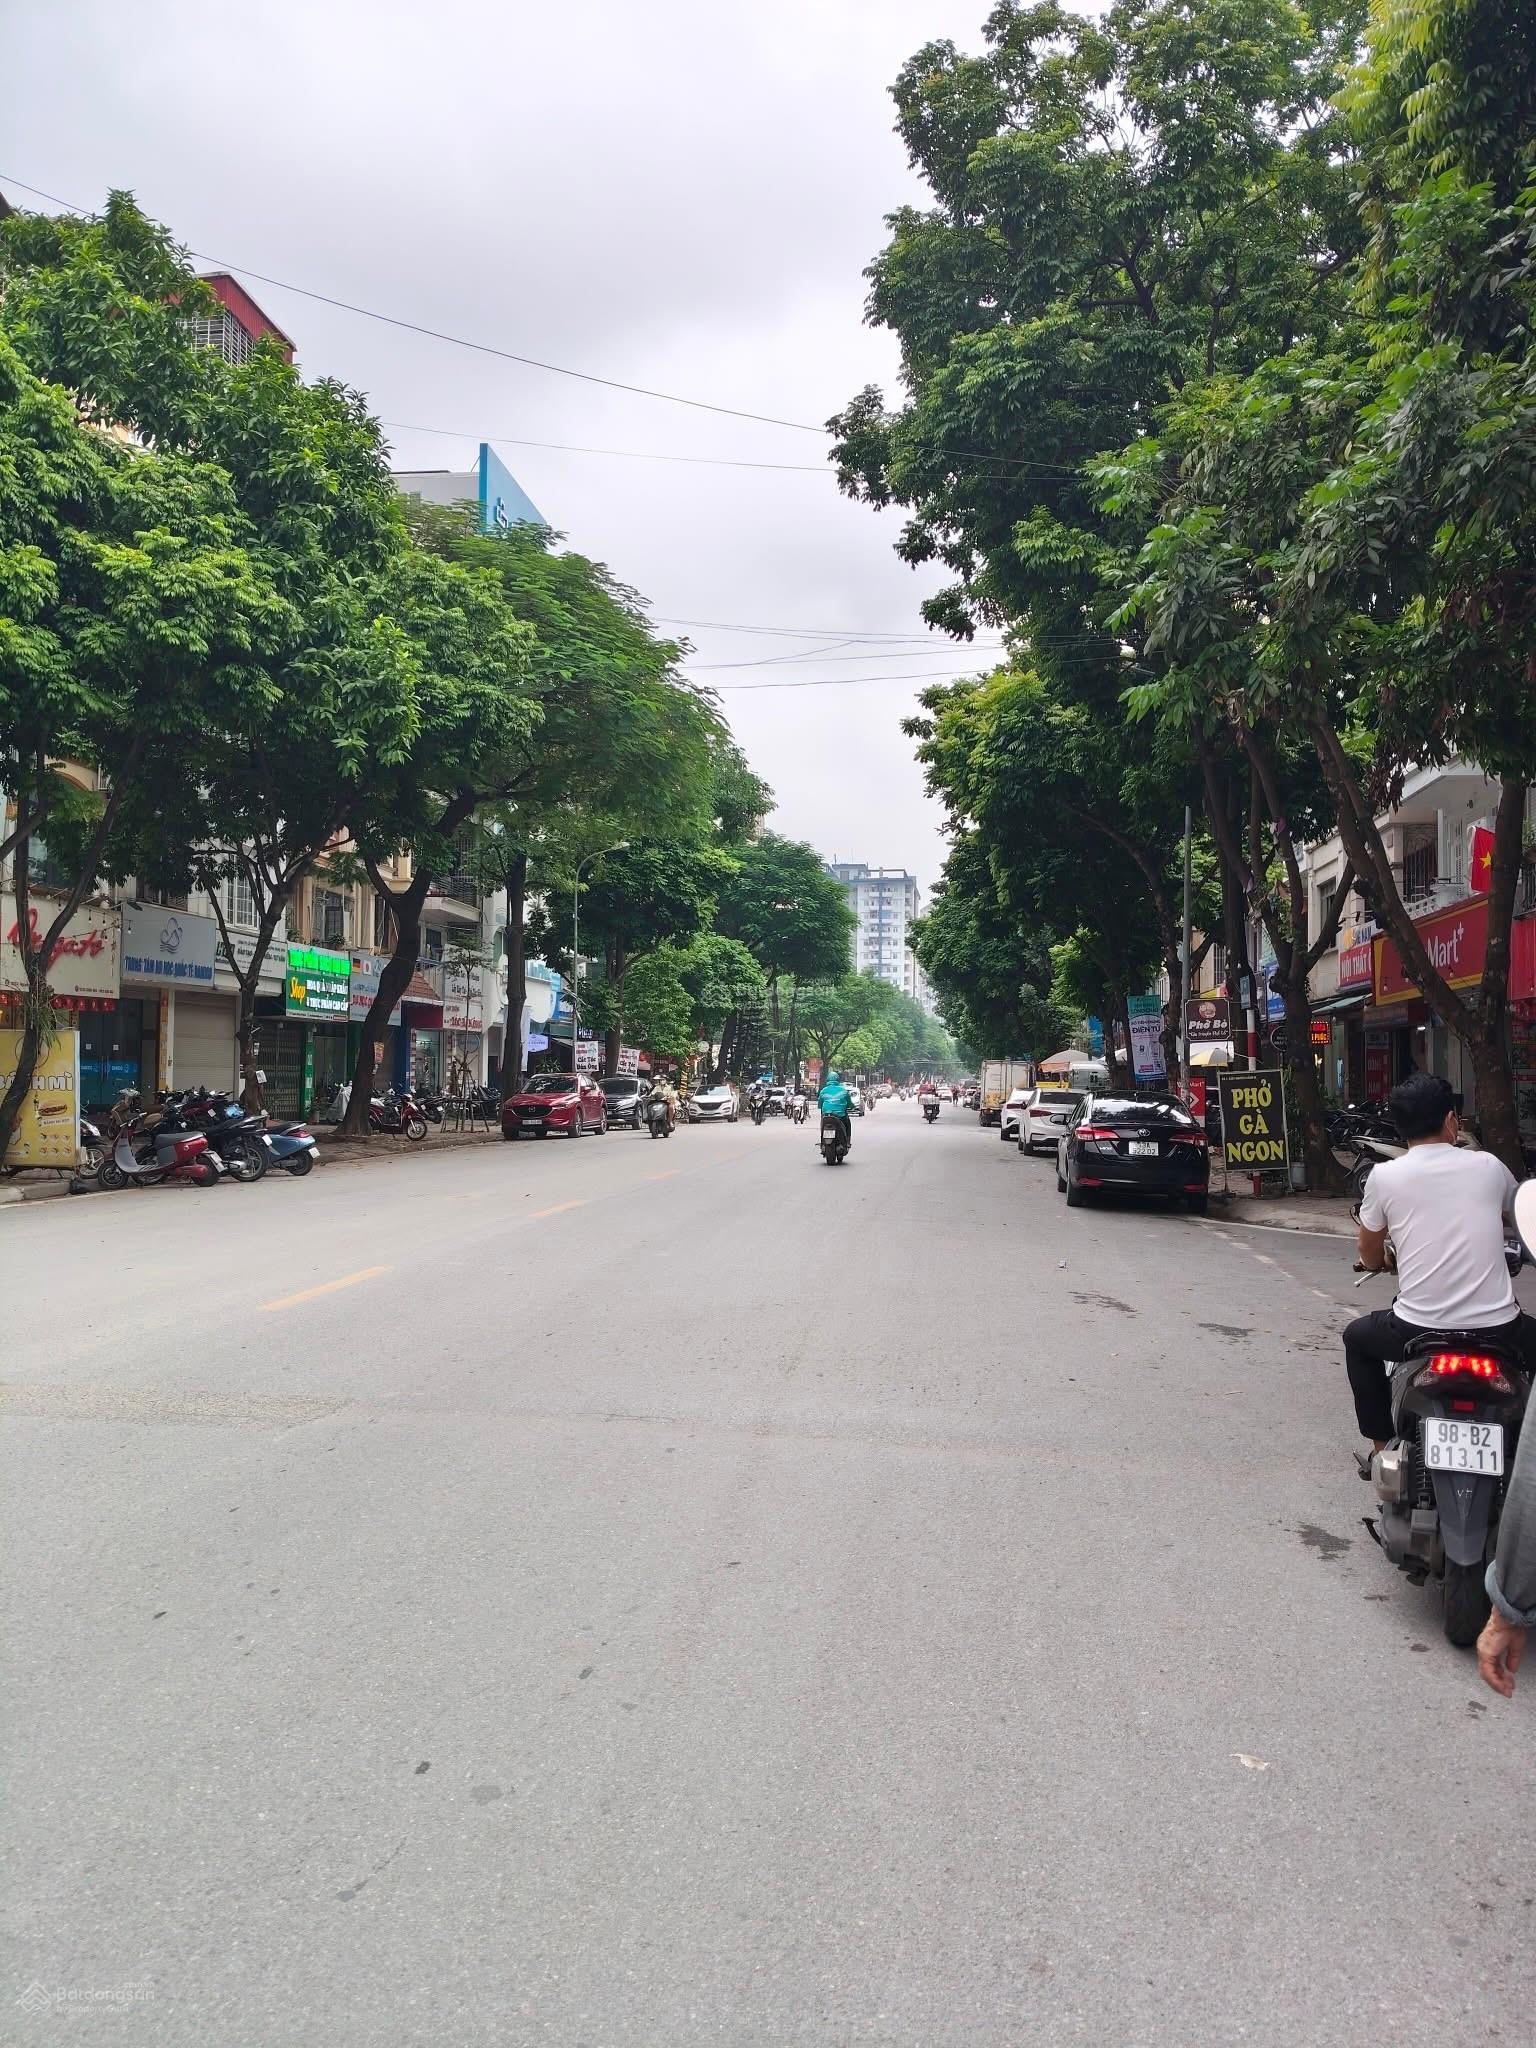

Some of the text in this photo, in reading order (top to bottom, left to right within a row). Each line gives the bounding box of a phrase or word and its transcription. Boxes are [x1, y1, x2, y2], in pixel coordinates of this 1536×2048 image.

[1425, 922, 1464, 968] Mart+
[1188, 1019, 1228, 1030] Phở Bò
[0, 1071, 74, 1092] BÁH MÌ
[1231, 1079, 1272, 1109] PHỞ
[1240, 1108, 1269, 1135] GÀ
[1226, 1140, 1284, 1163] NGON
[1438, 1422, 1491, 1448] 98-B2
[1431, 1444, 1497, 1472] 813.11
